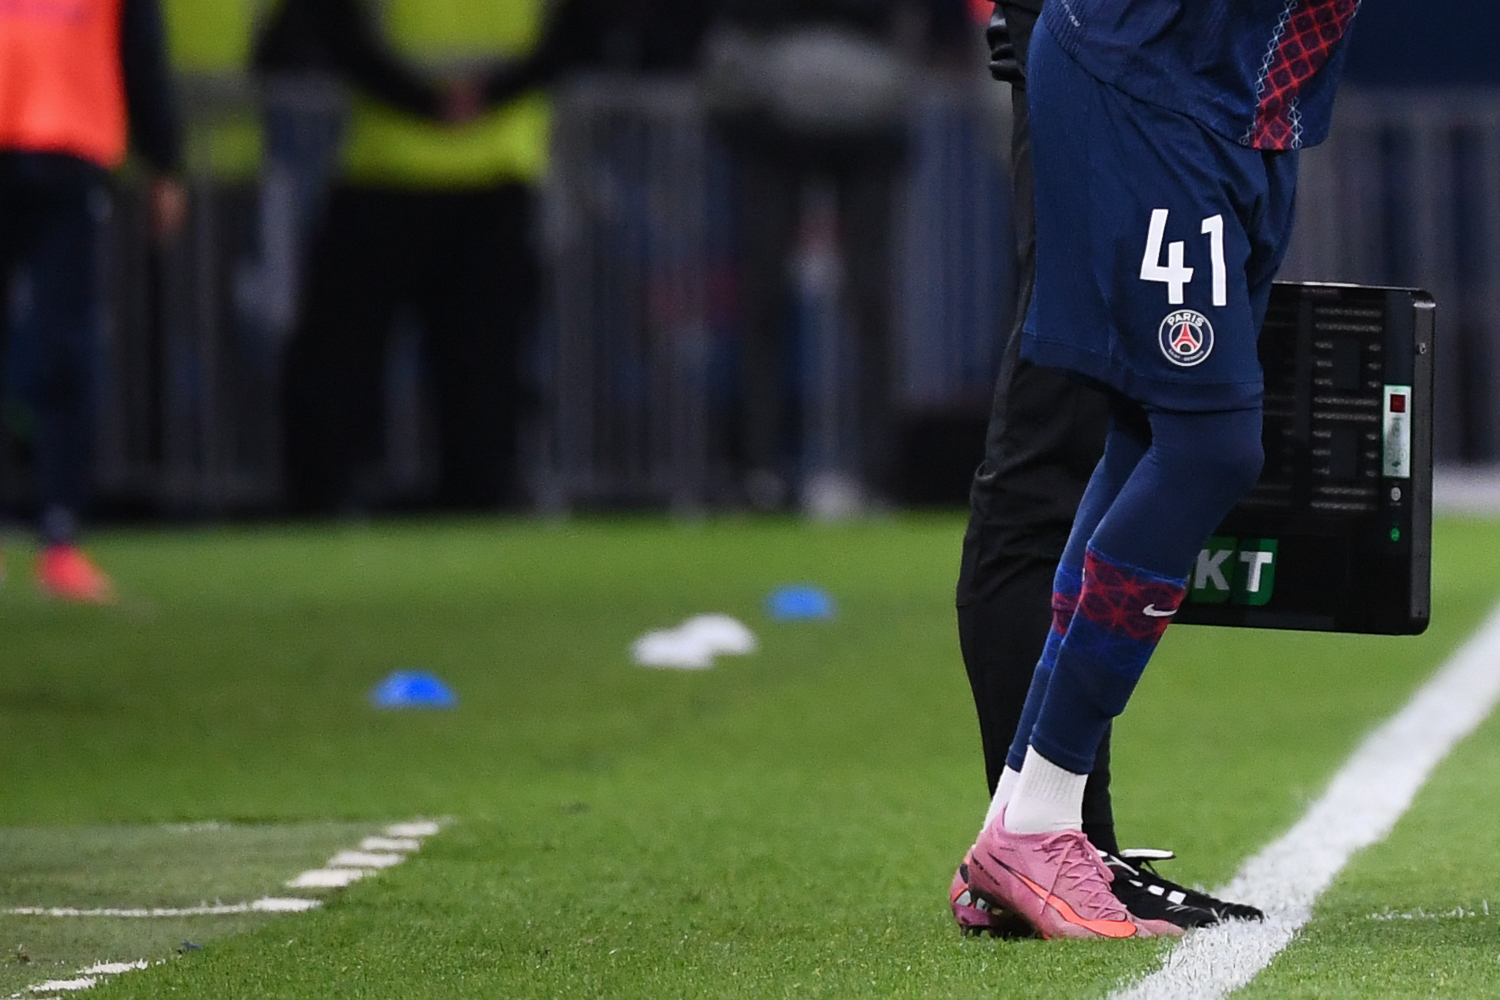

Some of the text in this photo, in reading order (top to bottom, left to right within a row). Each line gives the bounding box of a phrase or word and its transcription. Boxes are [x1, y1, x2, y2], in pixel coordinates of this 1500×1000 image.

[1140, 208, 1227, 306] 41
[1167, 312, 1205, 327] PARIS
[1194, 548, 1273, 592] KT
